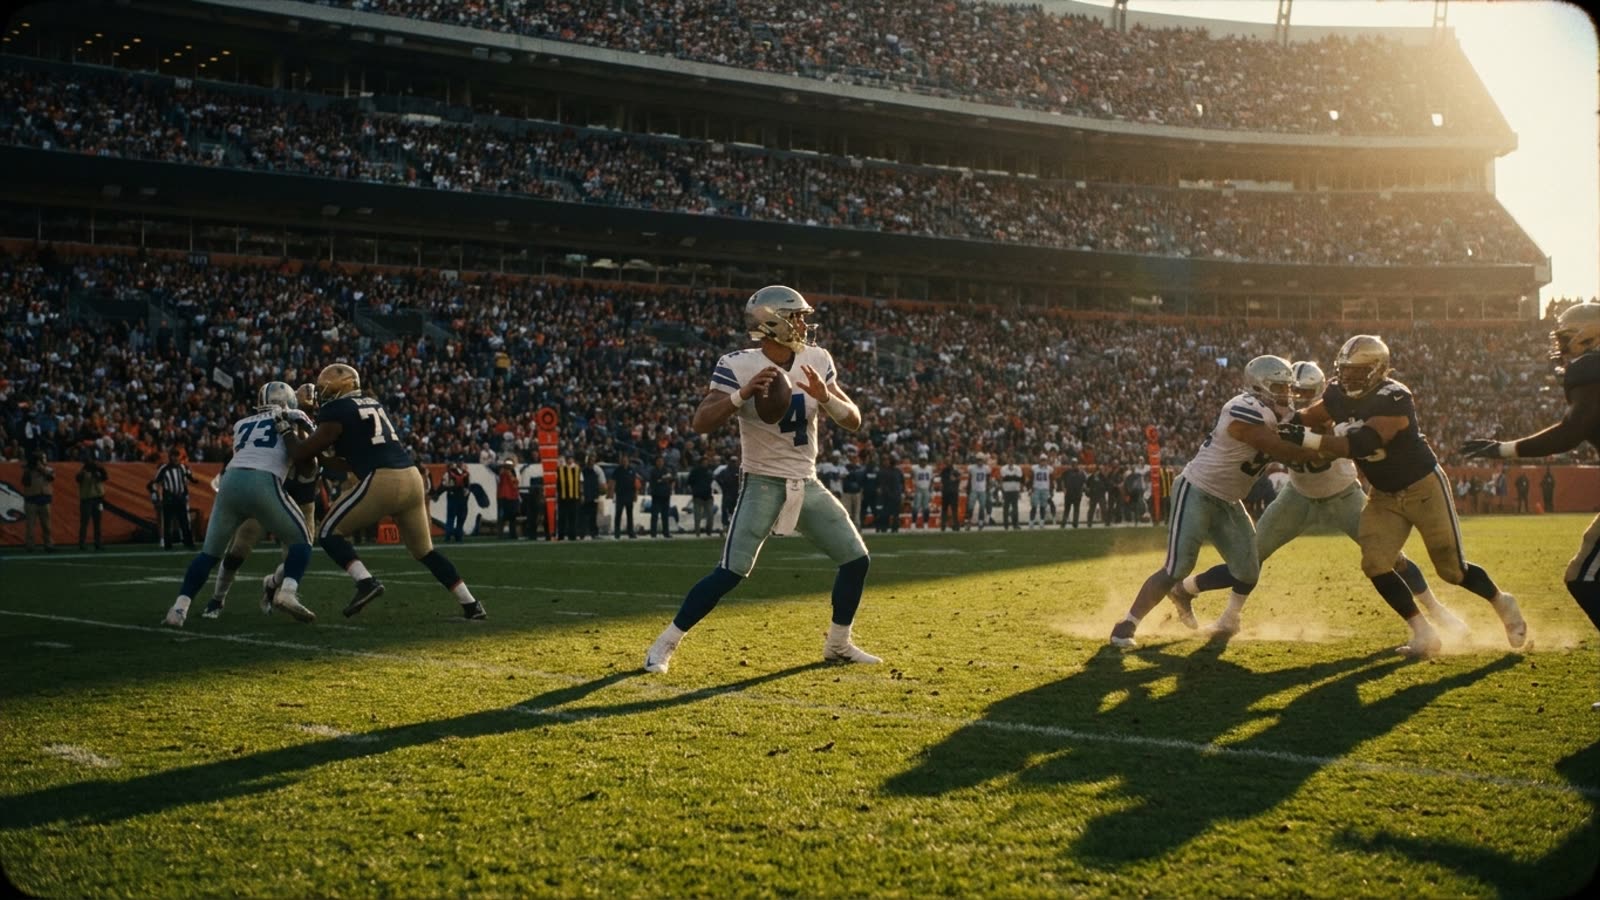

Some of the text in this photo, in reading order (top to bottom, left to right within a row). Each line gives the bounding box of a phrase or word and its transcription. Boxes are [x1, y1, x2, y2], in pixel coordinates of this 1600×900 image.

[234, 418, 279, 449] 73
[358, 407, 400, 445] 71
[778, 393, 808, 447] 4
